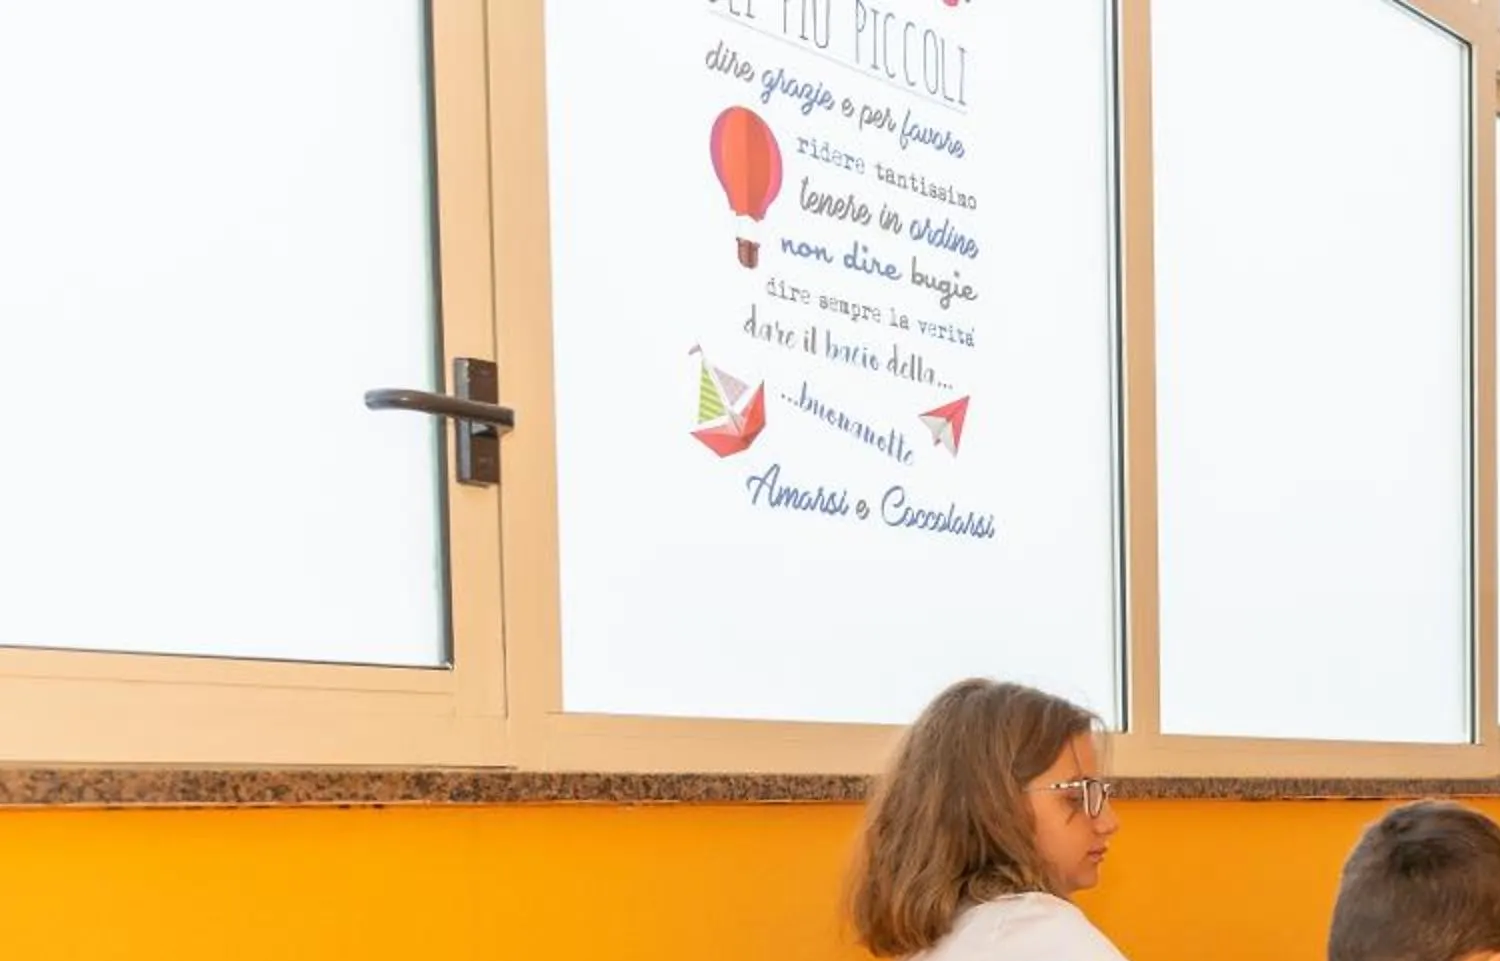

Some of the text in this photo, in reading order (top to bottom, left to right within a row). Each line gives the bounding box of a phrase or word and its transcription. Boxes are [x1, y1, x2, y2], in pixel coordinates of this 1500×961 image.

[854, 0, 968, 106] PICCOLI
[705, 40, 966, 160] dire grazie e per favore
[796, 136, 978, 211] ridere tantissimo
[799, 175, 980, 260] tenere in ordine
[766, 276, 812, 305] dire
[818, 294, 882, 323] sempre
[889, 305, 911, 332] la
[780, 236, 978, 310] non dire bugie
[743, 303, 797, 351] dare
[802, 326, 818, 354] il
[824, 329, 880, 372] bacio
[745, 462, 997, 540] Amarsi e Coccolarsi
